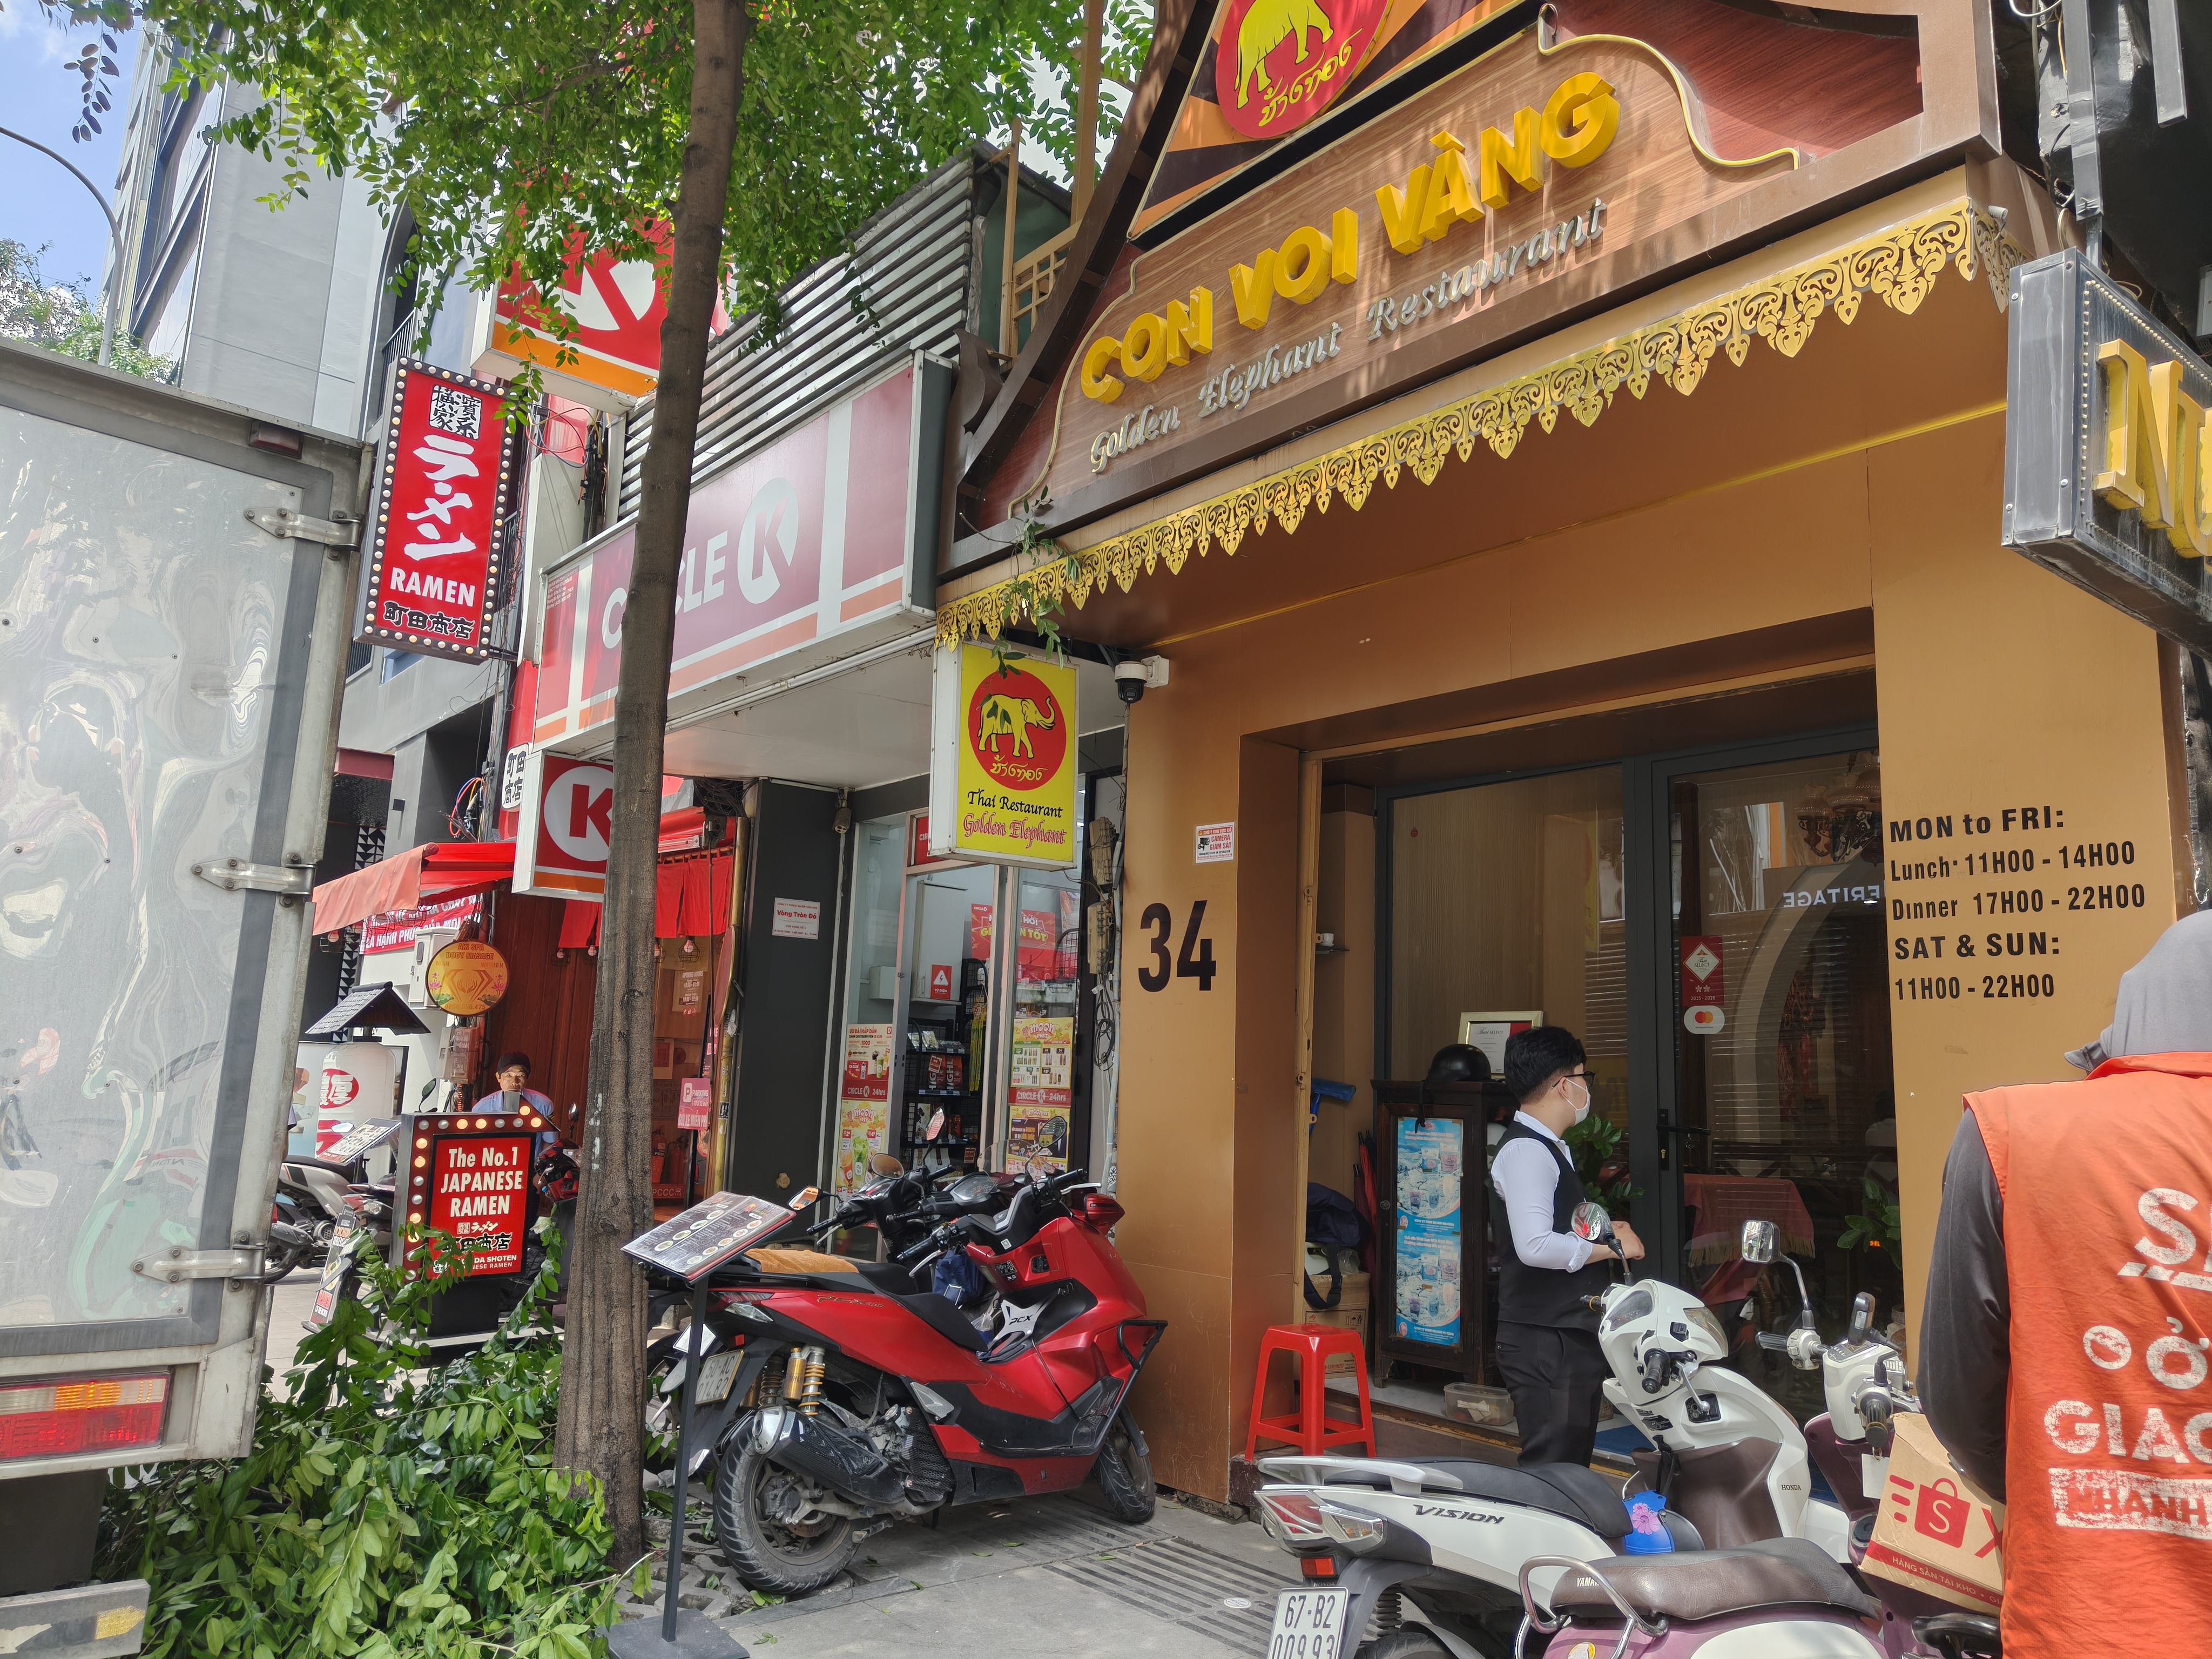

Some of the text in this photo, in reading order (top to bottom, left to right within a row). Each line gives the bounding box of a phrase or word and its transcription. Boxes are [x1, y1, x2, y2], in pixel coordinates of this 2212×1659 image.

[1081, 71, 1621, 404] CON VOI VÀNG
[1090, 197, 1607, 474] Golden Elephant Restaurant
[403, 434, 480, 562] ラーメン
[389, 567, 476, 608] RAMEN
[382, 600, 475, 640] 町田商店
[967, 788, 1063, 818] Thai Restaurant
[963, 811, 1067, 849] Golden Elephant
[1890, 805, 2063, 842] MON to FRI:
[1965, 848, 2035, 876] 11H00
[2059, 840, 2135, 869] 14H00
[777, 909, 792, 918] Vòng
[1973, 889, 2044, 915] 17H00
[2067, 884, 2145, 911] 22H00
[376, 930, 397, 949] HẠNH
[1137, 900, 1217, 993] 34
[1894, 932, 2059, 960] SAT & SUN:
[1895, 976, 1960, 1000] 11H00
[1982, 973, 2054, 998] 22H00
[847, 1087, 863, 1095] CIRCLE
[1016, 1091, 1037, 1100] CIRCLE
[1049, 1092, 1066, 1101] 24hrs
[448, 1147, 476, 1168] The
[440, 1170, 523, 1194] JAPANESE
[450, 1195, 510, 1218] RAMEN
[471, 1220, 498, 1233] ラーメン
[487, 1255, 517, 1263] SHOTEN
[1008, 1314, 1034, 1326] PCX
[1412, 1504, 1505, 1525] VISION
[1892, 1556, 1917, 1572] HÀNG
[1939, 1575, 1954, 1587] TẠI
[1955, 1582, 1977, 1595] KHO
